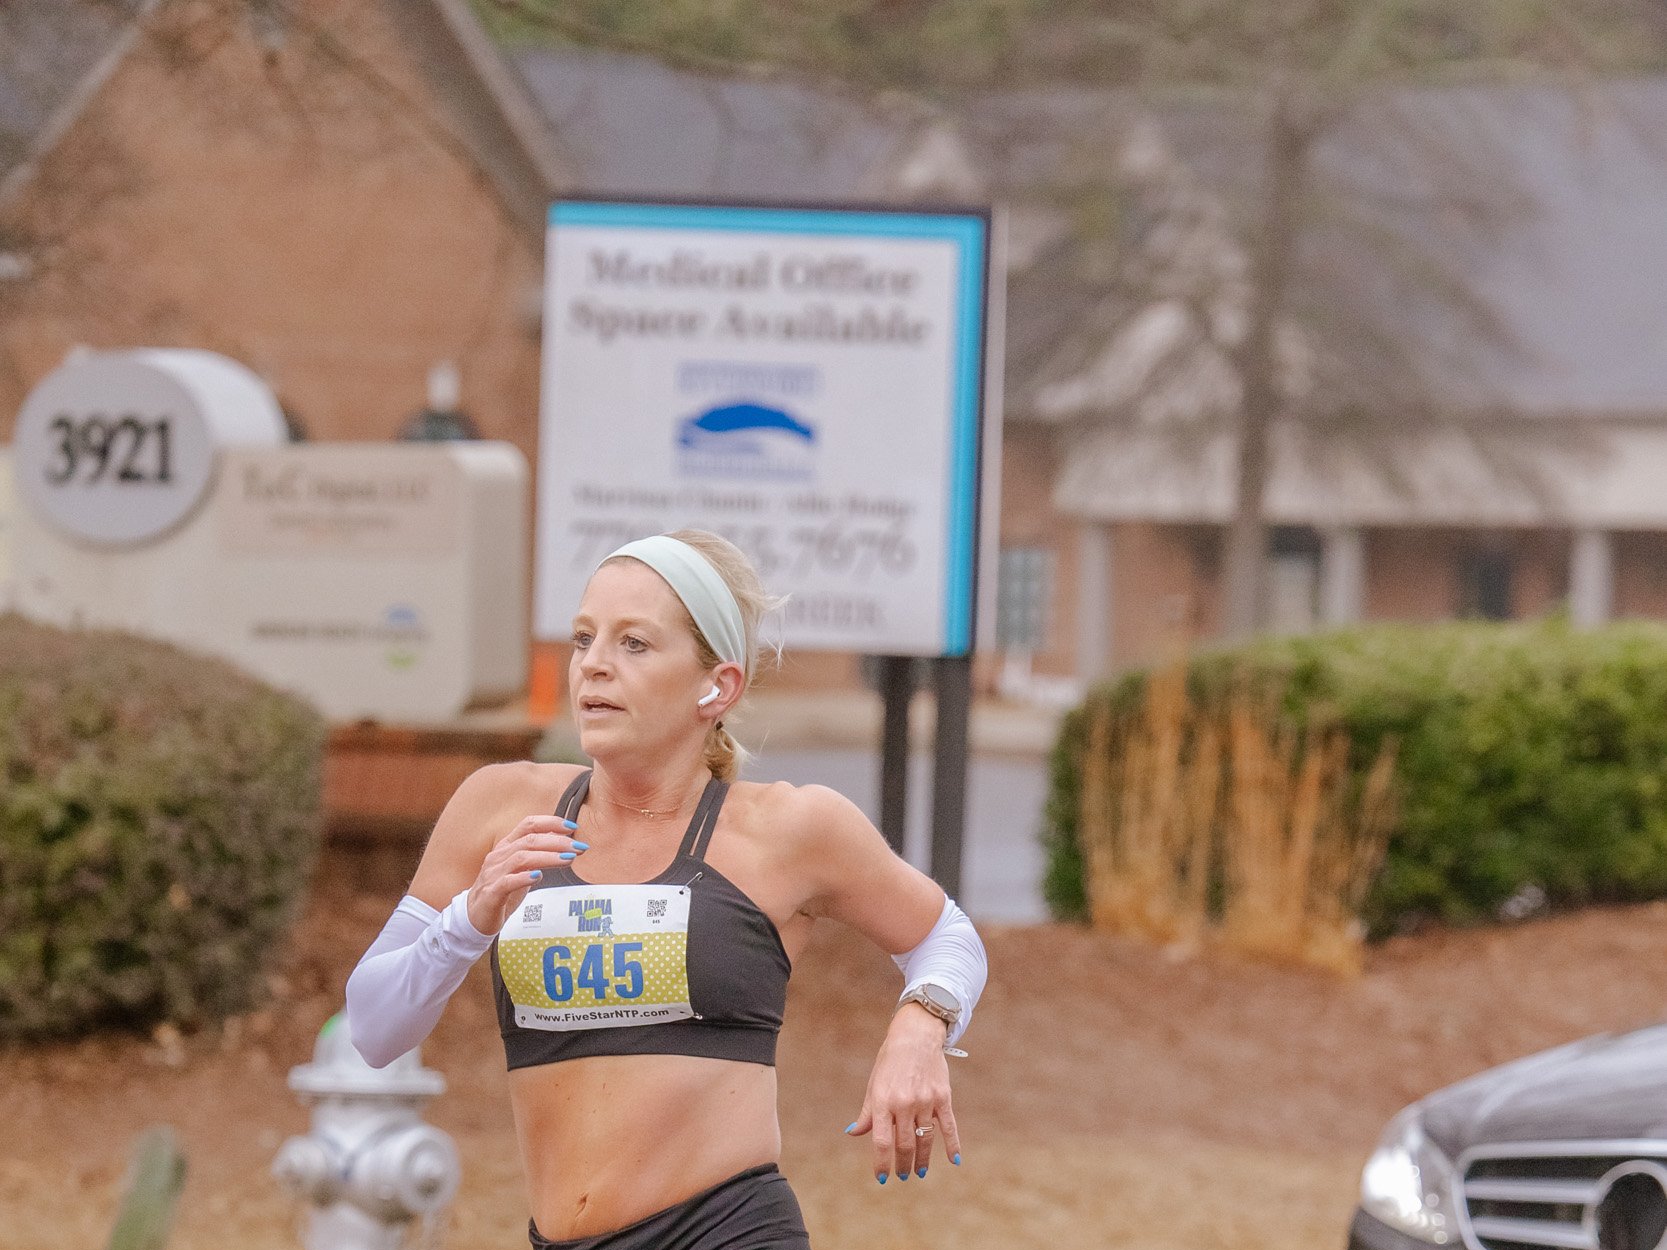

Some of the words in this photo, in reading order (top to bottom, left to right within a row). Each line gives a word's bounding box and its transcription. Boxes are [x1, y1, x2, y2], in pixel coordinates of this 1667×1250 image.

[46, 415, 177, 487] 3921
[543, 942, 644, 1002] 645
[534, 1009, 670, 1023] www.FiveStarNTP.com
